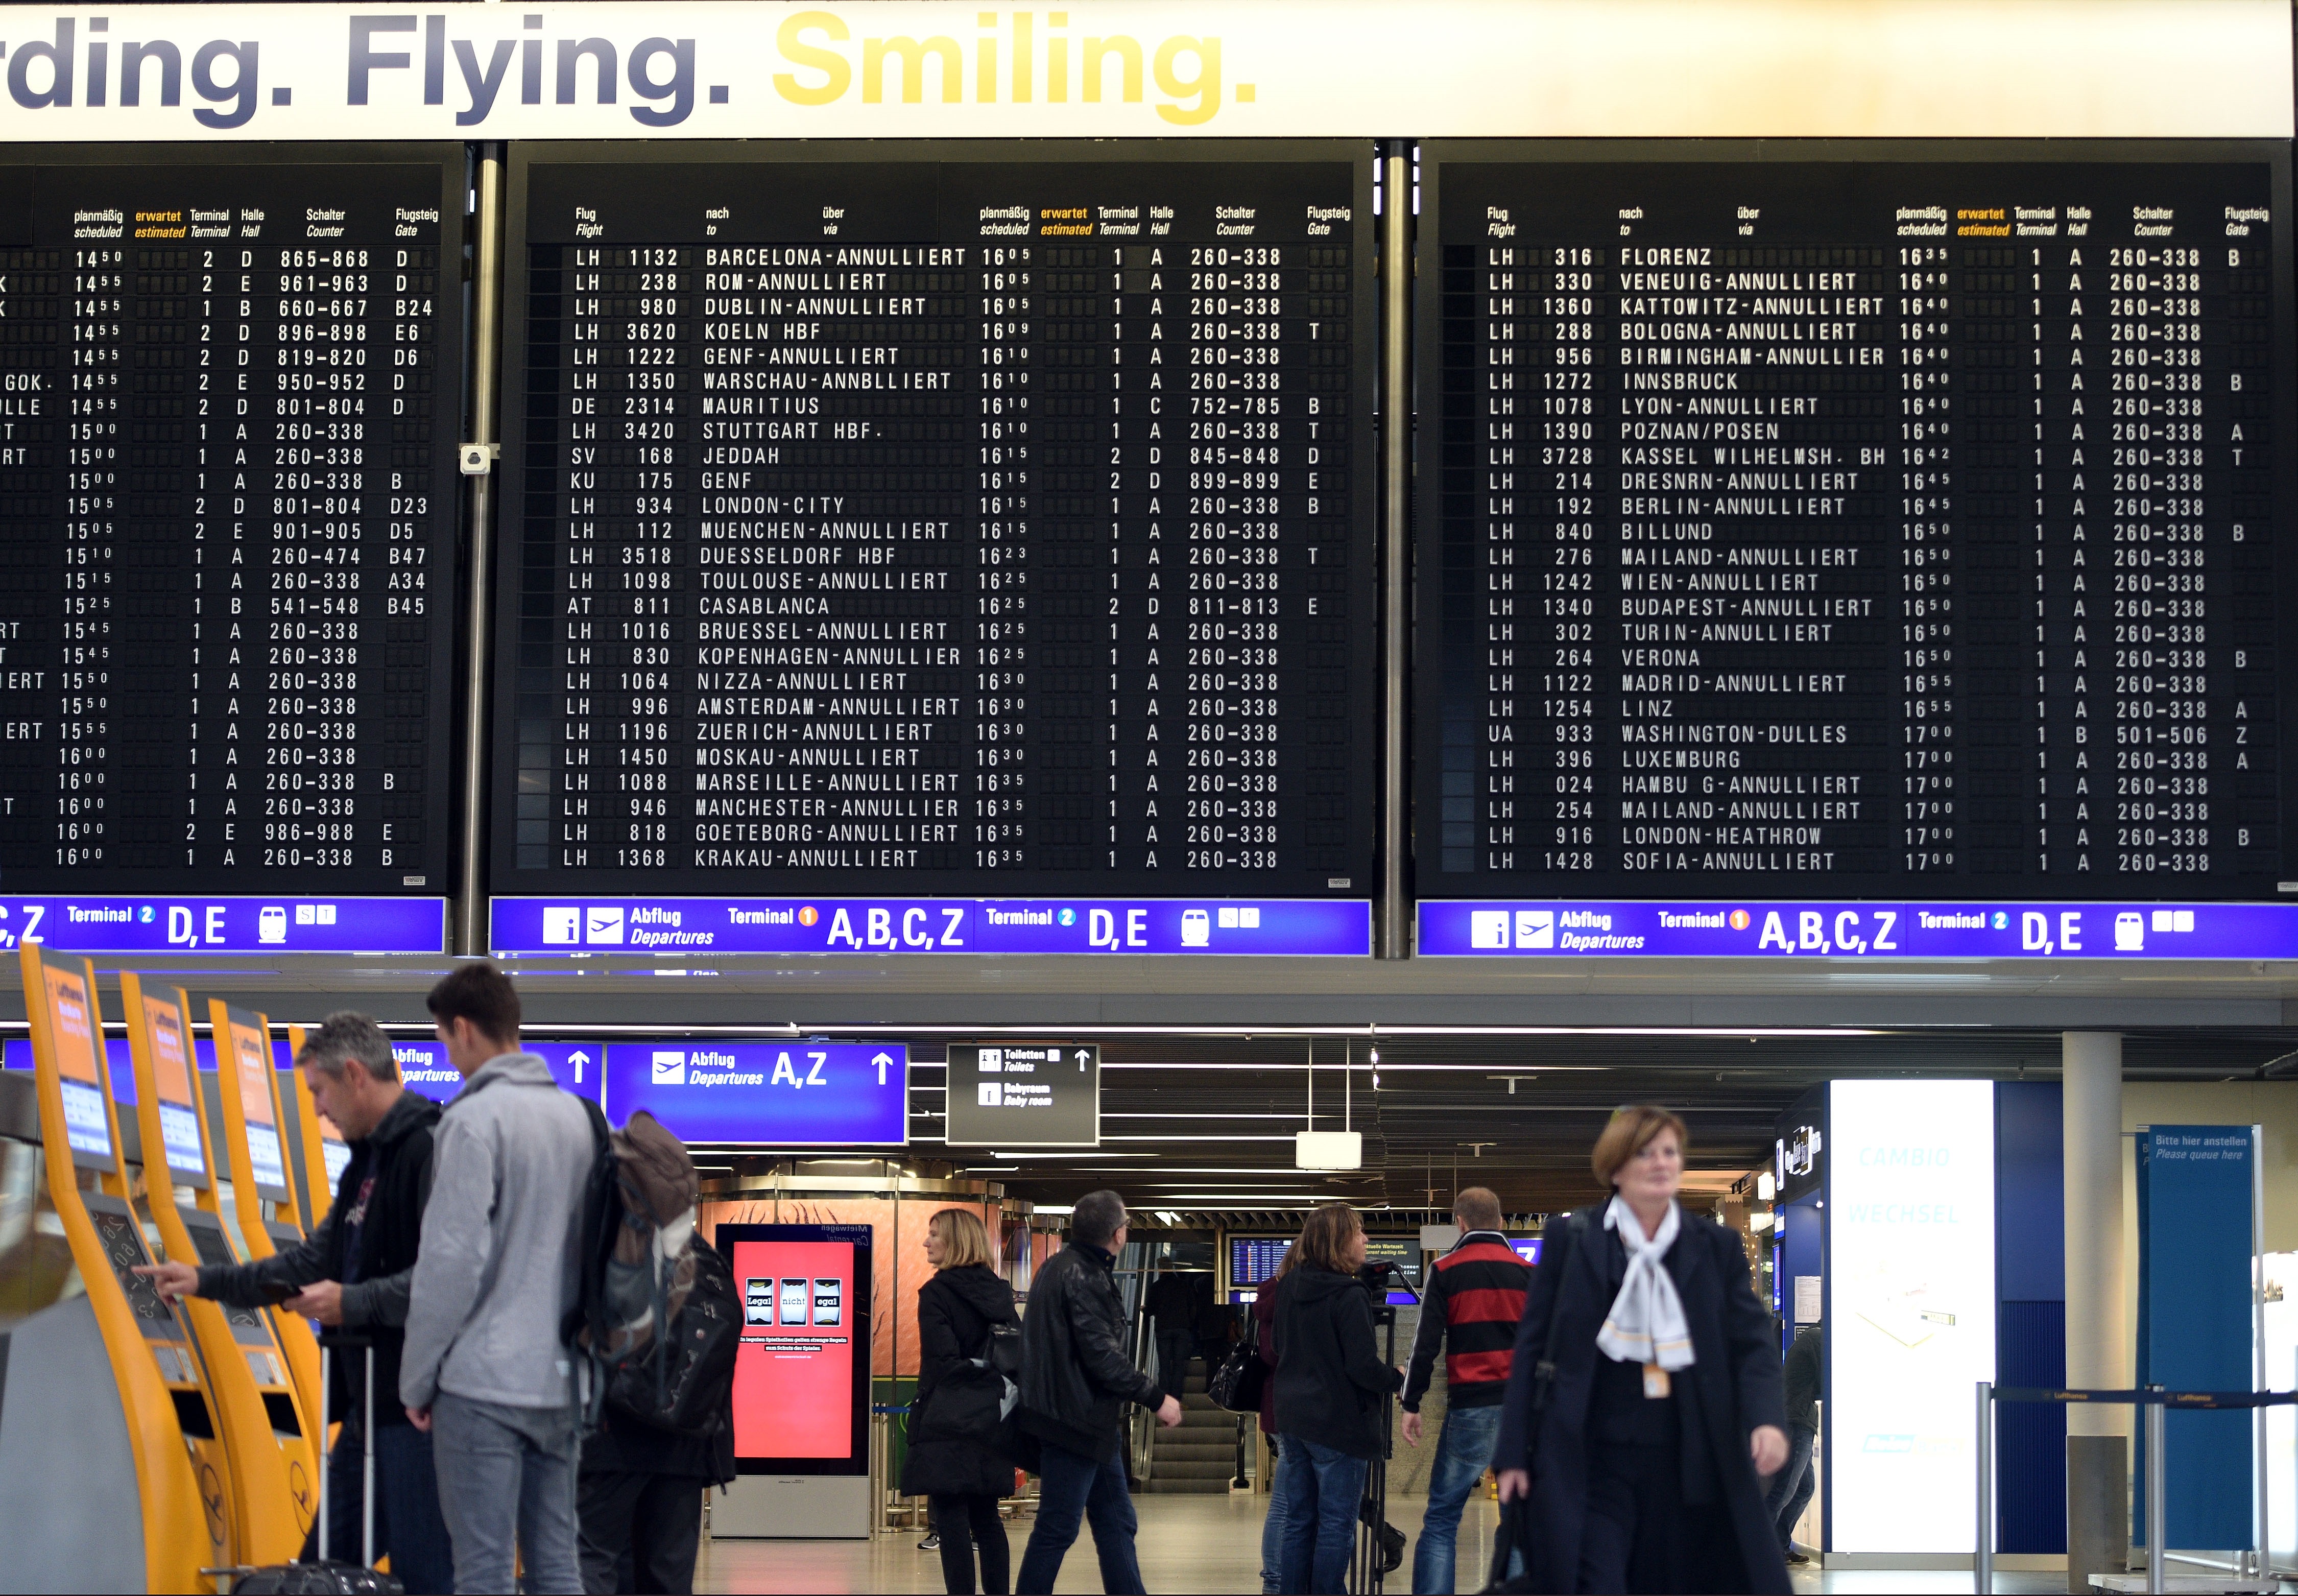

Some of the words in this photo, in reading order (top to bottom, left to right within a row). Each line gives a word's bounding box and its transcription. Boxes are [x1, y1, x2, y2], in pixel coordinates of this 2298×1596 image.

[0, 14, 295, 132] ding.
[347, 14, 729, 128] Flying.
[772, 10, 1259, 125] Smiling.
[74, 209, 123, 224] planmäßig
[135, 210, 181, 222] erwartet
[189, 209, 229, 221] Terminal
[241, 208, 265, 221] Halle
[306, 208, 346, 221] Schalter
[395, 207, 439, 222] Flugsteig
[576, 207, 596, 222] Flug
[706, 206, 729, 219] nach
[823, 206, 845, 219] über
[980, 206, 1030, 221] planmäßig
[1041, 208, 1087, 219] erwartet
[1097, 206, 1138, 219] Terminal
[1150, 206, 1174, 219] Halle
[1215, 206, 1255, 219] Schalter
[1307, 206, 1350, 221] Flugsteig
[1487, 206, 1508, 222] Flug
[1619, 206, 1643, 219] nach
[1737, 206, 1760, 219] über
[1896, 206, 1947, 222] planmäßig
[1957, 208, 2005, 220] erwartet
[2014, 206, 2055, 220] Terminal
[2067, 206, 2092, 220] Halle
[2133, 206, 2173, 220] Schalter
[2225, 206, 2269, 222] Flugsteig
[74, 225, 123, 238] scheduled
[135, 225, 186, 238] estimated
[191, 225, 231, 237] Terminal
[241, 225, 260, 237] Hall
[306, 225, 345, 237] Counter
[395, 224, 418, 236] Gate
[576, 223, 604, 239] Flight
[706, 224, 716, 235] to
[824, 223, 838, 235] via
[980, 222, 1030, 235] scheduled
[1041, 223, 1093, 235] estimated
[1099, 222, 1140, 235] Terminal
[1150, 222, 1170, 235] Hall
[1216, 222, 1255, 235] Counter
[1307, 222, 1330, 235] Gate
[1488, 223, 1516, 239] Flight
[1620, 224, 1631, 236] to
[1738, 222, 1753, 235] via
[1897, 223, 1948, 236] scheduled
[1957, 223, 2011, 236] estimated
[2016, 223, 2057, 236] Terminal
[2067, 223, 2088, 236] Hall
[2134, 223, 2173, 236] Counter
[2225, 222, 2249, 236] Gate
[281, 250, 368, 268] 865-868
[707, 248, 965, 266] BARCELONA-ANNULLIERT
[1621, 248, 1711, 266] FLORENZ
[706, 273, 886, 291] ROM-ANNULLIERT
[396, 299, 432, 316] B24
[705, 323, 768, 340] KOELN
[784, 323, 820, 340] HBF
[278, 373, 364, 391] 950-952
[704, 372, 950, 390] WARSCHAU-ANNBLLIERT
[1624, 372, 1738, 390] INNSBRUCK
[572, 398, 595, 414] DE
[625, 397, 674, 414] 2314
[703, 397, 818, 414] MAURITIUS
[703, 422, 818, 439] STUTTGART
[834, 422, 880, 439] HBF.
[1621, 422, 1778, 440] POZNAN/POSEN
[703, 447, 778, 464] JEDDAH
[391, 497, 426, 514] D23
[703, 496, 844, 514] LONDON-CITY
[1622, 523, 1712, 540] BILLUND
[700, 597, 829, 614] CASABLANCA
[1621, 649, 1699, 666] VERONA
[1622, 700, 1672, 717] LINZ
[1621, 725, 1847, 743] WASHINGTON-DULLES
[1623, 750, 1740, 768] LUXEMBURG
[265, 823, 353, 841] 986-988
[1623, 826, 1821, 845] LONDON-HEATHROW
[696, 849, 918, 867] KRAKAU-ANNULLIERT
[67, 906, 132, 922] Terminal
[141, 907, 152, 922] 2
[168, 906, 226, 948] D,E
[630, 907, 681, 927] Abflug
[728, 908, 794, 924] Terminal
[804, 909, 811, 924] 1
[827, 908, 964, 950] A,B,C,Z
[986, 908, 1052, 925] Terminal
[1061, 909, 1072, 925] 2
[1089, 909, 1147, 951] D,E
[1559, 911, 1612, 931] Abflug
[1658, 911, 1725, 928] Terminal
[1735, 911, 1743, 928] 1
[1758, 911, 1897, 954] A,B,C,Z
[1918, 911, 1985, 928] Terminal
[1994, 912, 2006, 929] 2
[2022, 912, 2082, 955] D,E
[630, 928, 714, 948] Departures
[1560, 932, 1644, 951] Departures
[1003, 1049, 1045, 1060] Toiletten
[689, 1052, 735, 1069] Abflug
[771, 1052, 827, 1089] A,Z
[1004, 1061, 1035, 1072] Toilets
[401, 1069, 460, 1084] epartures
[689, 1070, 763, 1088] Departures
[1004, 1082, 1050, 1095] Babyraum
[1003, 1095, 1028, 1108] Baby
[1028, 1097, 1052, 1106] room
[2156, 1135, 2179, 1145] Bitte
[2183, 1135, 2200, 1146] hier
[2204, 1136, 2246, 1146] anstellen
[1859, 1147, 1950, 1166] CAMBIO
[2156, 1149, 2187, 1158] Please
[2190, 1151, 2218, 1159] queue
[2221, 1150, 2242, 1159] here
[1849, 1204, 1959, 1224] WECHSEL
[748, 1296, 772, 1306] Legal
[817, 1297, 837, 1306] egal
